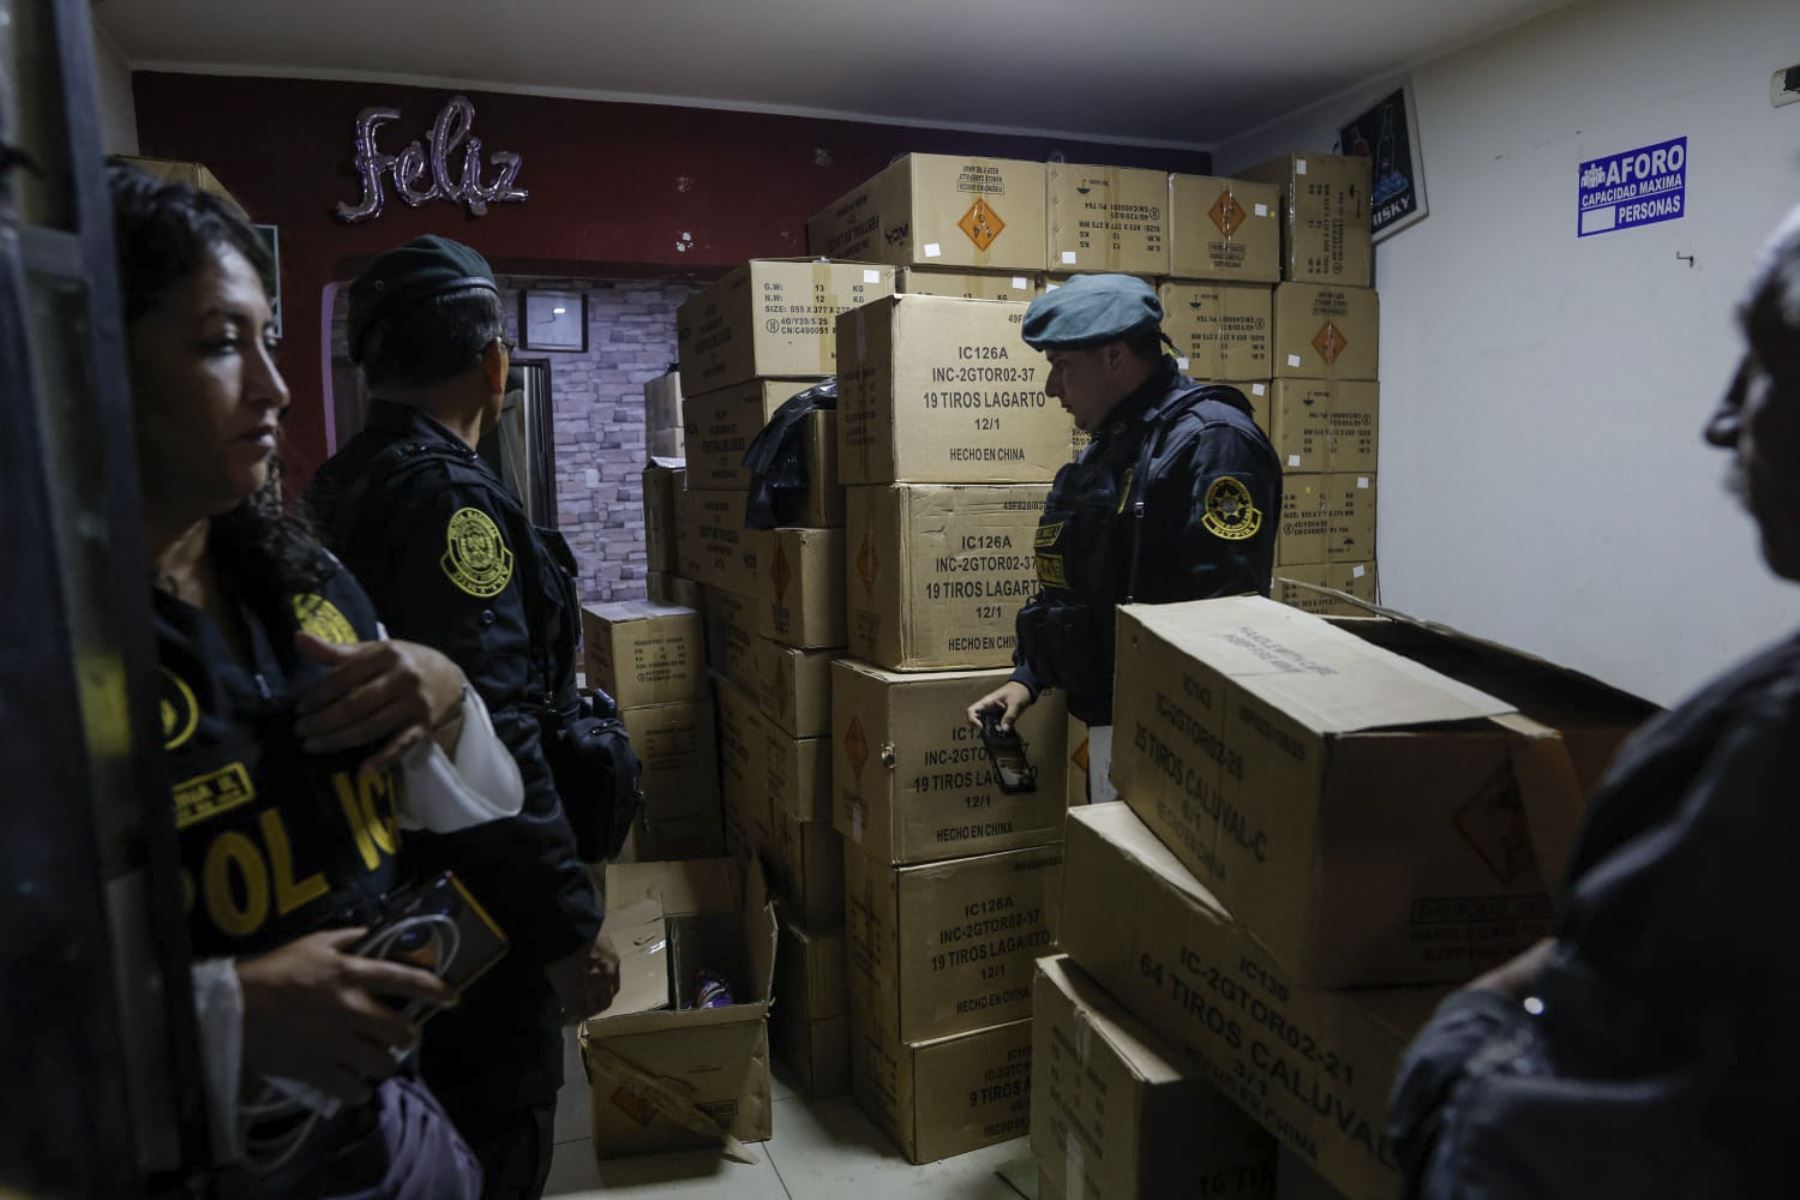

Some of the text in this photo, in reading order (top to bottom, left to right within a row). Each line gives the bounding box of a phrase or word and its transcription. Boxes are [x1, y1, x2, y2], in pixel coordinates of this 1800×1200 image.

[1605, 144, 1685, 187] AFORO
[1582, 173, 1682, 207] CAPACIDAD MAXIMA
[1618, 195, 1681, 224] PERSONAS
[958, 346, 1009, 360] IC126A
[932, 367, 1035, 382] INC-2GTOR02-37
[923, 391, 1046, 408] 19 TIROS LAGARTO
[974, 418, 1000, 431] 12/1
[950, 448, 1025, 461] HECHO EN CHINA
[962, 535, 1012, 549] IC126A
[925, 579, 1041, 599] 19 TIROS LAGART
[976, 606, 1003, 619] 12/1
[949, 637, 980, 651] HECHO
[983, 636, 995, 650] EN
[914, 776, 929, 793] 19
[931, 771, 972, 791] TIROS
[965, 794, 992, 809] 12/1
[936, 821, 1014, 842] HECHO EN CHINA
[965, 896, 1014, 918] IC126A
[931, 929, 1051, 971] 19 TIROS LAGARTO
[981, 964, 1006, 980] 12/1
[957, 996, 987, 1015] HECHO
[1171, 971, 1241, 1049] TIROS
[980, 1080, 1021, 1105] TIROS
